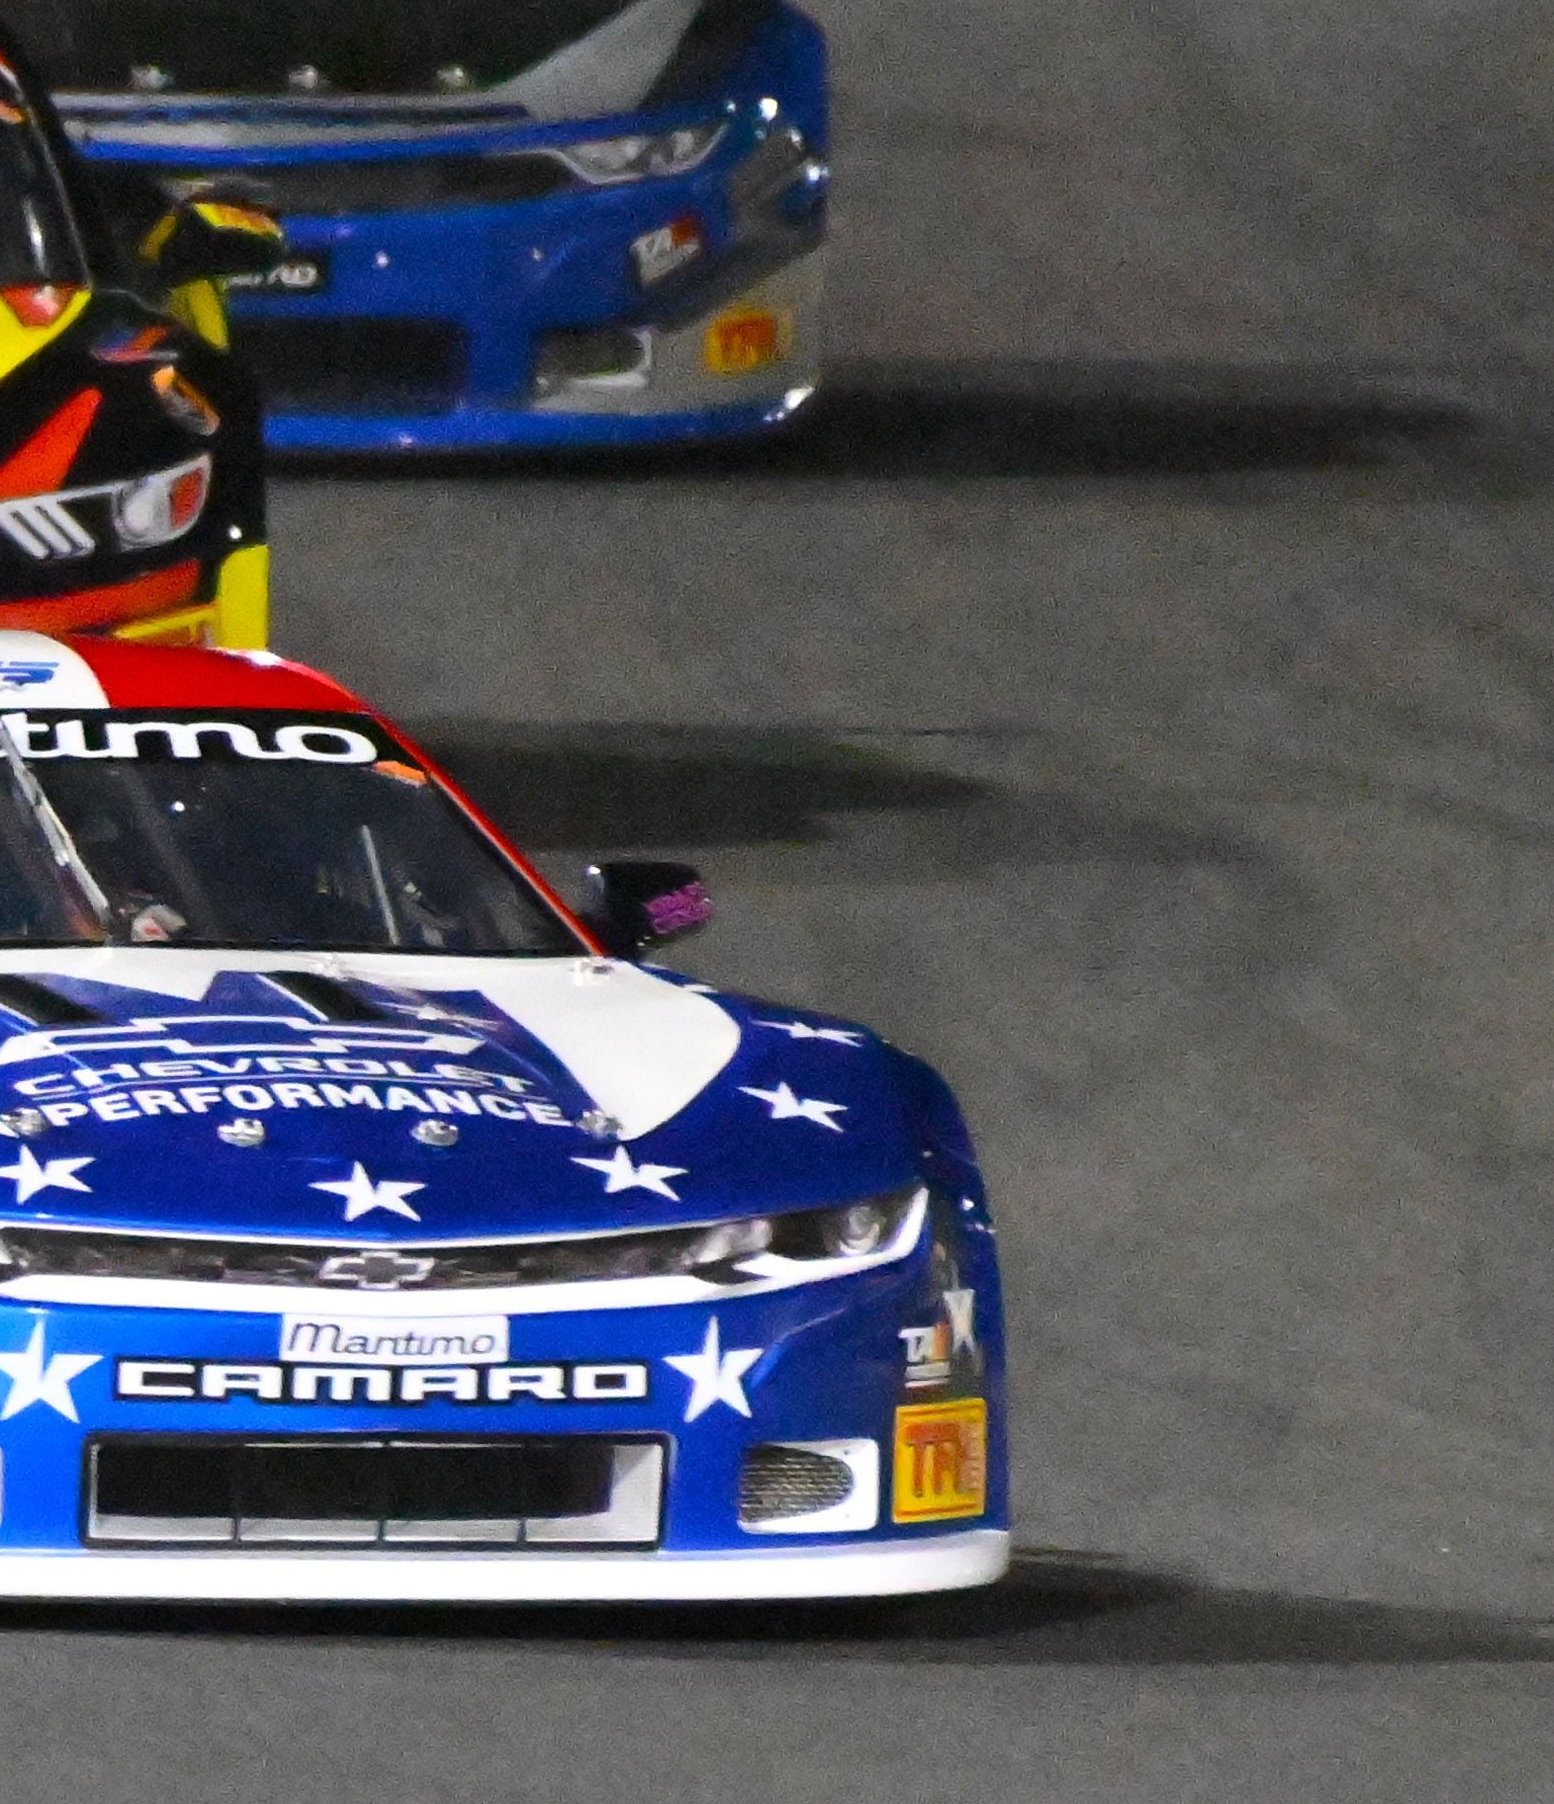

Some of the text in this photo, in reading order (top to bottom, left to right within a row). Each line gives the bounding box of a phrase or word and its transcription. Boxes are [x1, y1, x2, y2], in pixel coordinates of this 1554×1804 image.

[12, 1056, 536, 1096] CHEVROLET
[35, 1082, 575, 1128] PERFORMANCE
[118, 1360, 648, 1401] CAMARO
